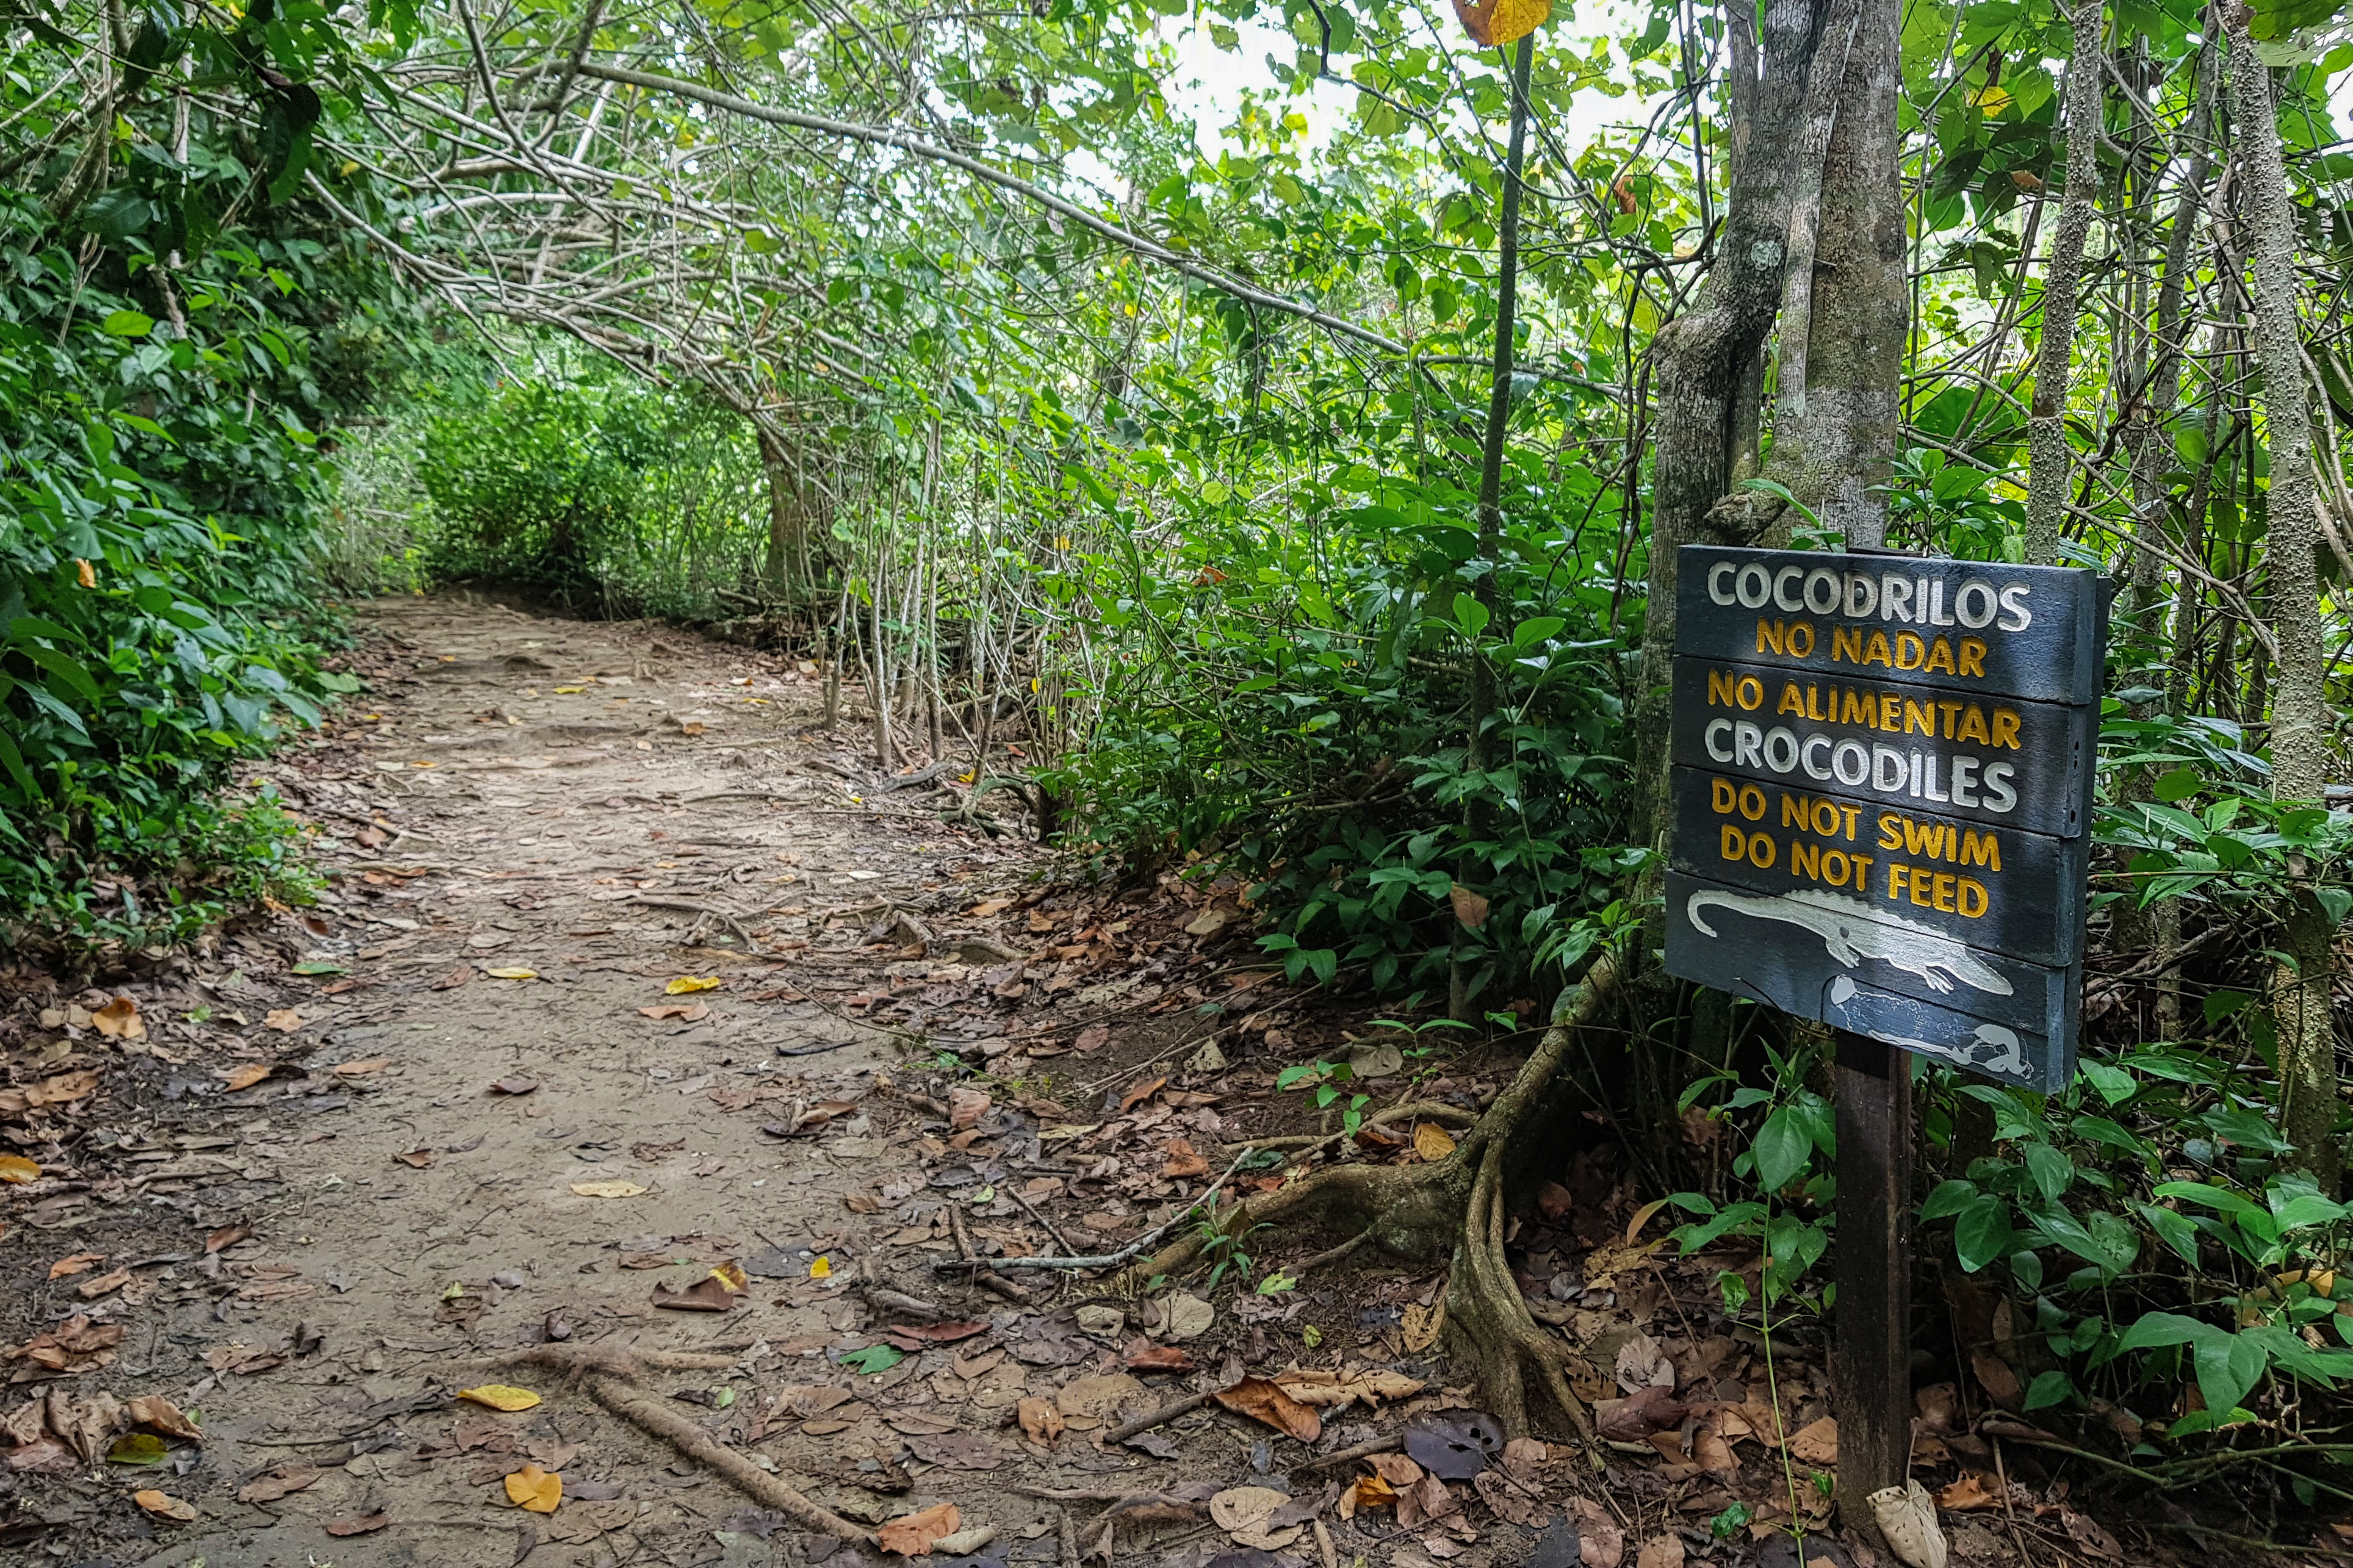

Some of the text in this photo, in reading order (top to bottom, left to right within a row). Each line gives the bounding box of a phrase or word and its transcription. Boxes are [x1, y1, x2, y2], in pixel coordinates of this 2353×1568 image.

[1708, 561, 2033, 631] COCODRILOS
[1756, 616, 1987, 678] NO NADAR
[1708, 669, 2022, 750] NO ALIMENTAR
[1705, 717, 2017, 813] CROCODILES
[1712, 777, 2001, 872] DO NOT SWIM
[1721, 824, 1989, 918] DO NOT FEED
